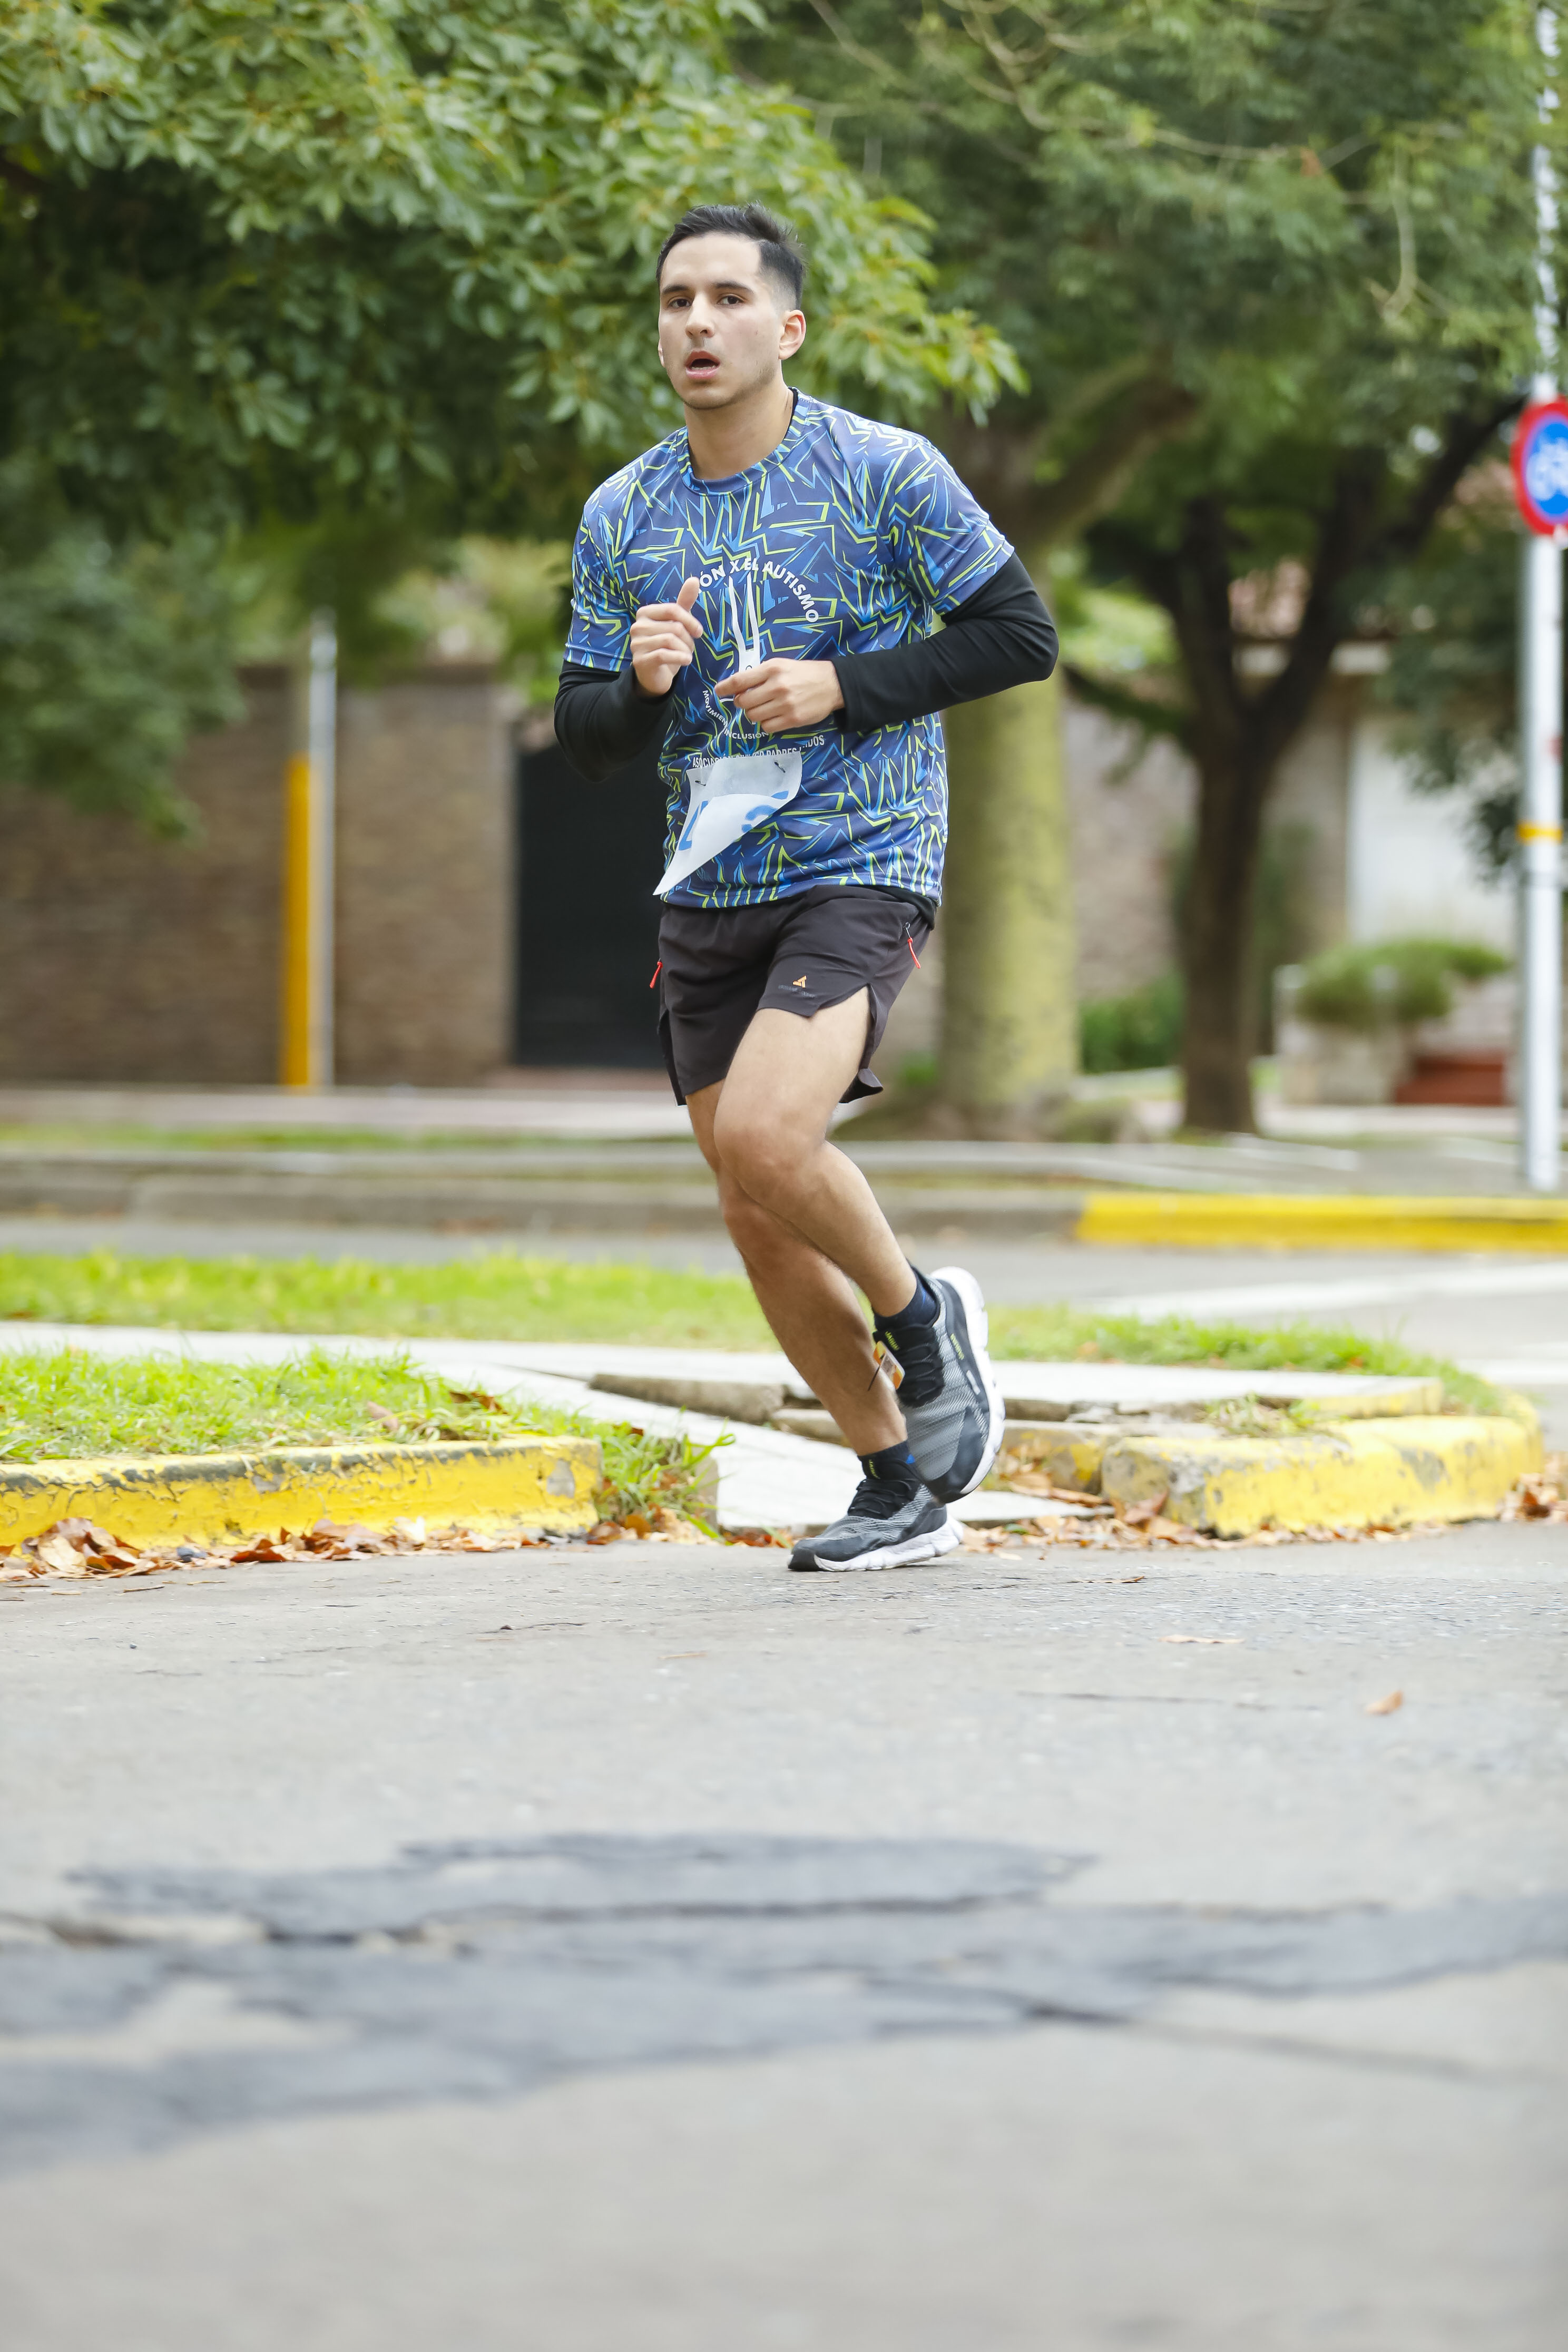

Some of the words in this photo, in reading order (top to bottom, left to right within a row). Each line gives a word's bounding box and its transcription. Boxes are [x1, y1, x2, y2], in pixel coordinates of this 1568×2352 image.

[699, 565, 726, 594] ÓN
[729, 560, 741, 574] X
[744, 558, 759, 571] EL
[762, 561, 819, 623] AUTISMO
[702, 690, 728, 728] MOVIMIEN
